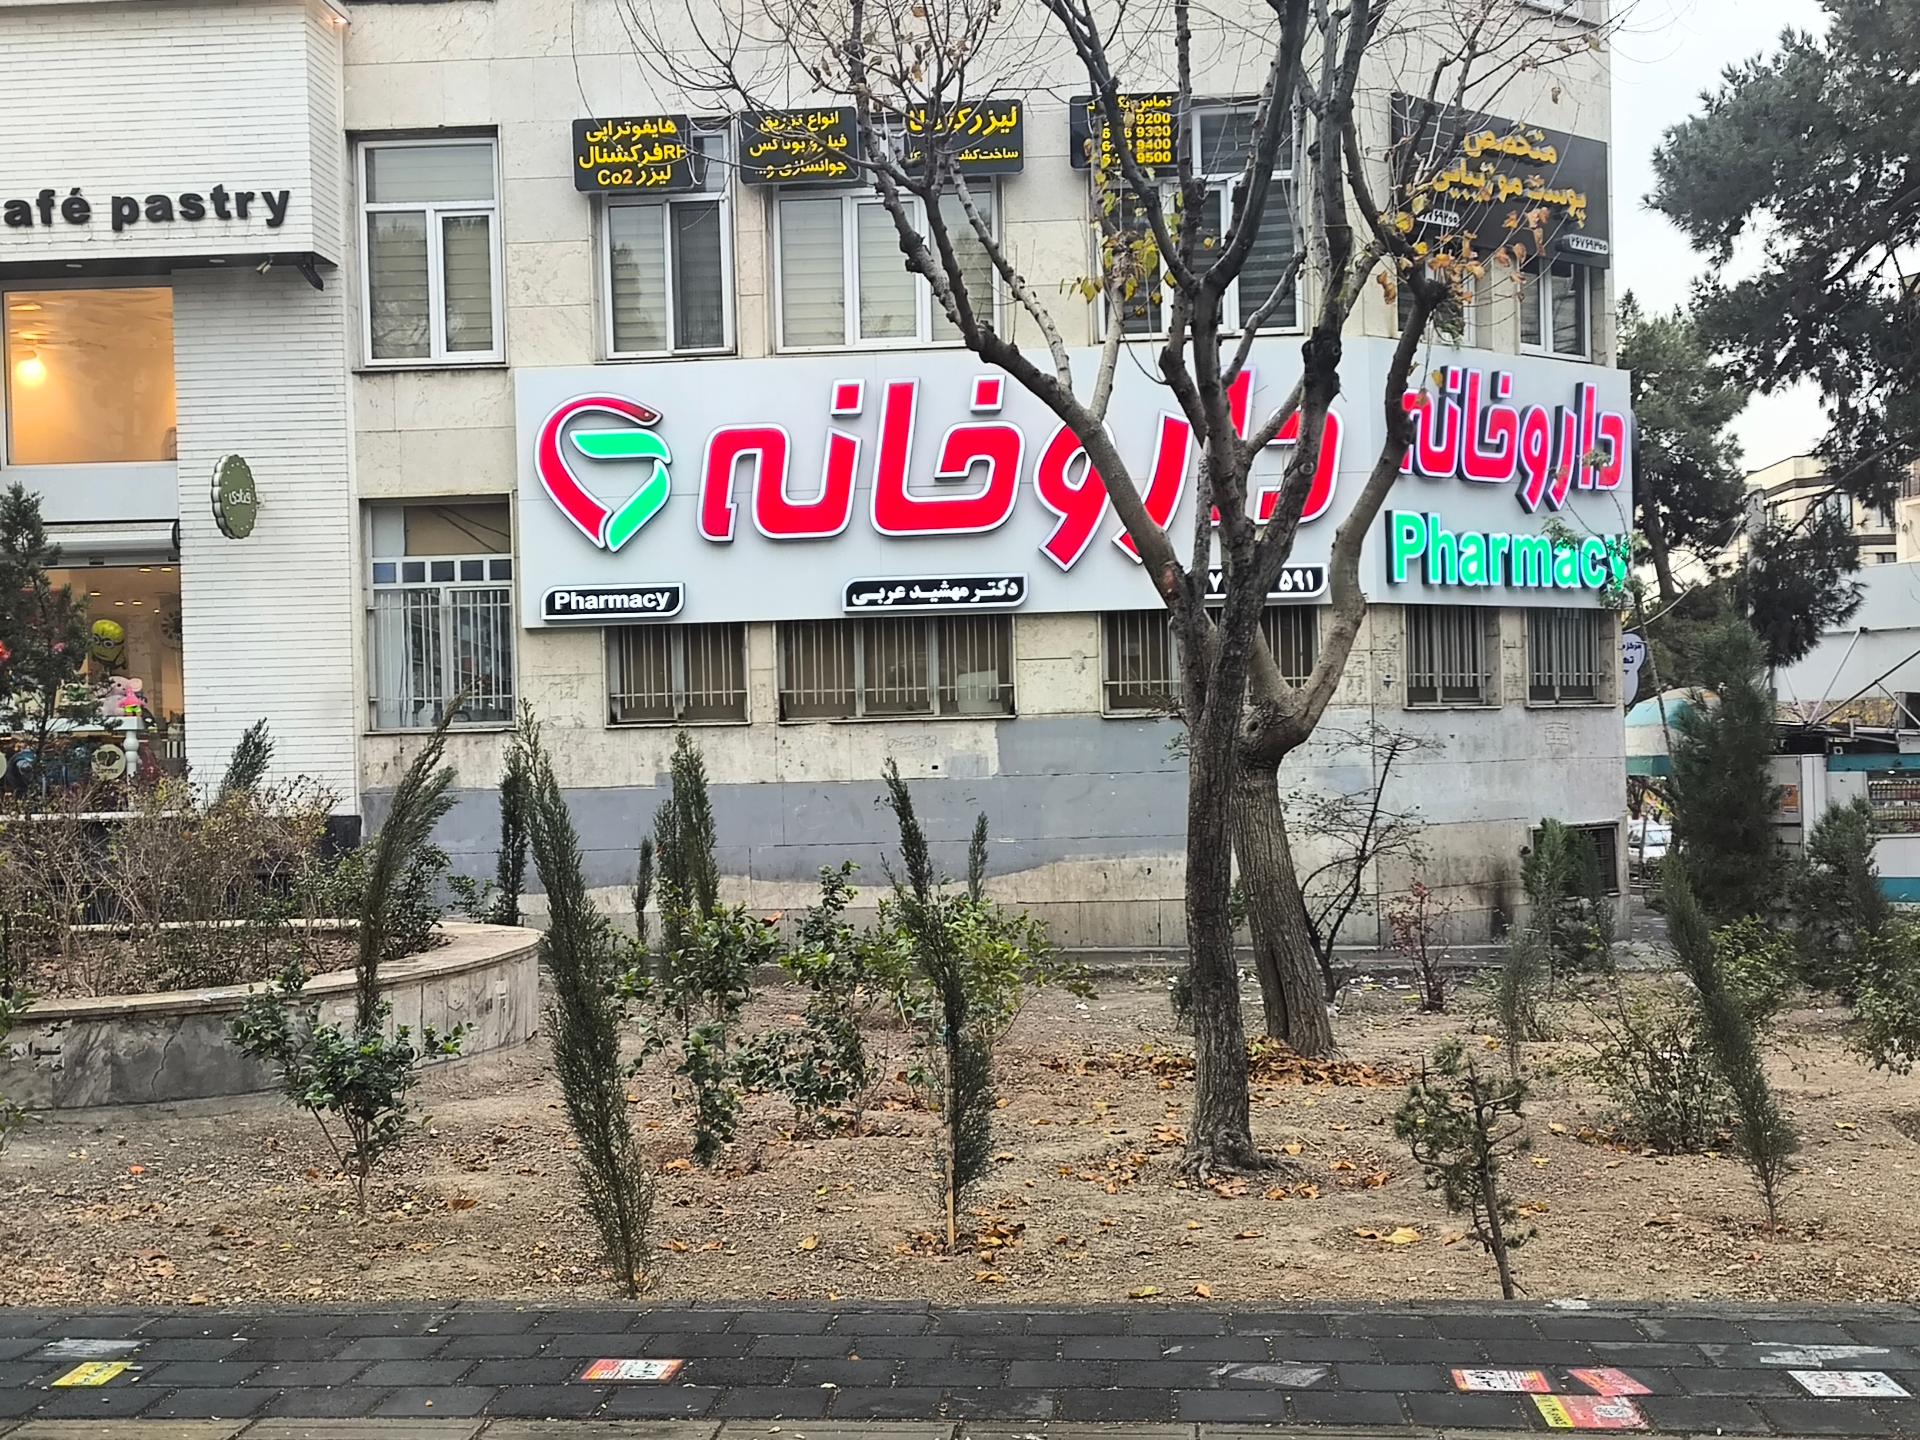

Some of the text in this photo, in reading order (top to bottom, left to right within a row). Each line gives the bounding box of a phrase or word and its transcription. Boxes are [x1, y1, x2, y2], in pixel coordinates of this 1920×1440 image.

[1136, 95, 1172, 112] تماس
[807, 111, 839, 132] انواع
[968, 106, 1017, 135] لیزر
[1136, 113, 1171, 125] 9200
[586, 118, 677, 142] هایفوتراپی
[1136, 125, 1171, 138] 9300
[579, 143, 664, 168] فرکشنال
[979, 148, 1019, 160] ساخت
[1137, 138, 1171, 152] 9400
[779, 159, 848, 177] جوانسازی
[1137, 151, 1172, 164] 9500
[597, 165, 672, 186] لیزر Co2
[111, 183, 290, 232] pastry
[1400, 366, 1626, 513] داروخانه
[1390, 509, 1631, 592] Pharmacy
[554, 591, 670, 611] Pharmacy
[852, 579, 1018, 605] دکتر مهشید عربی
